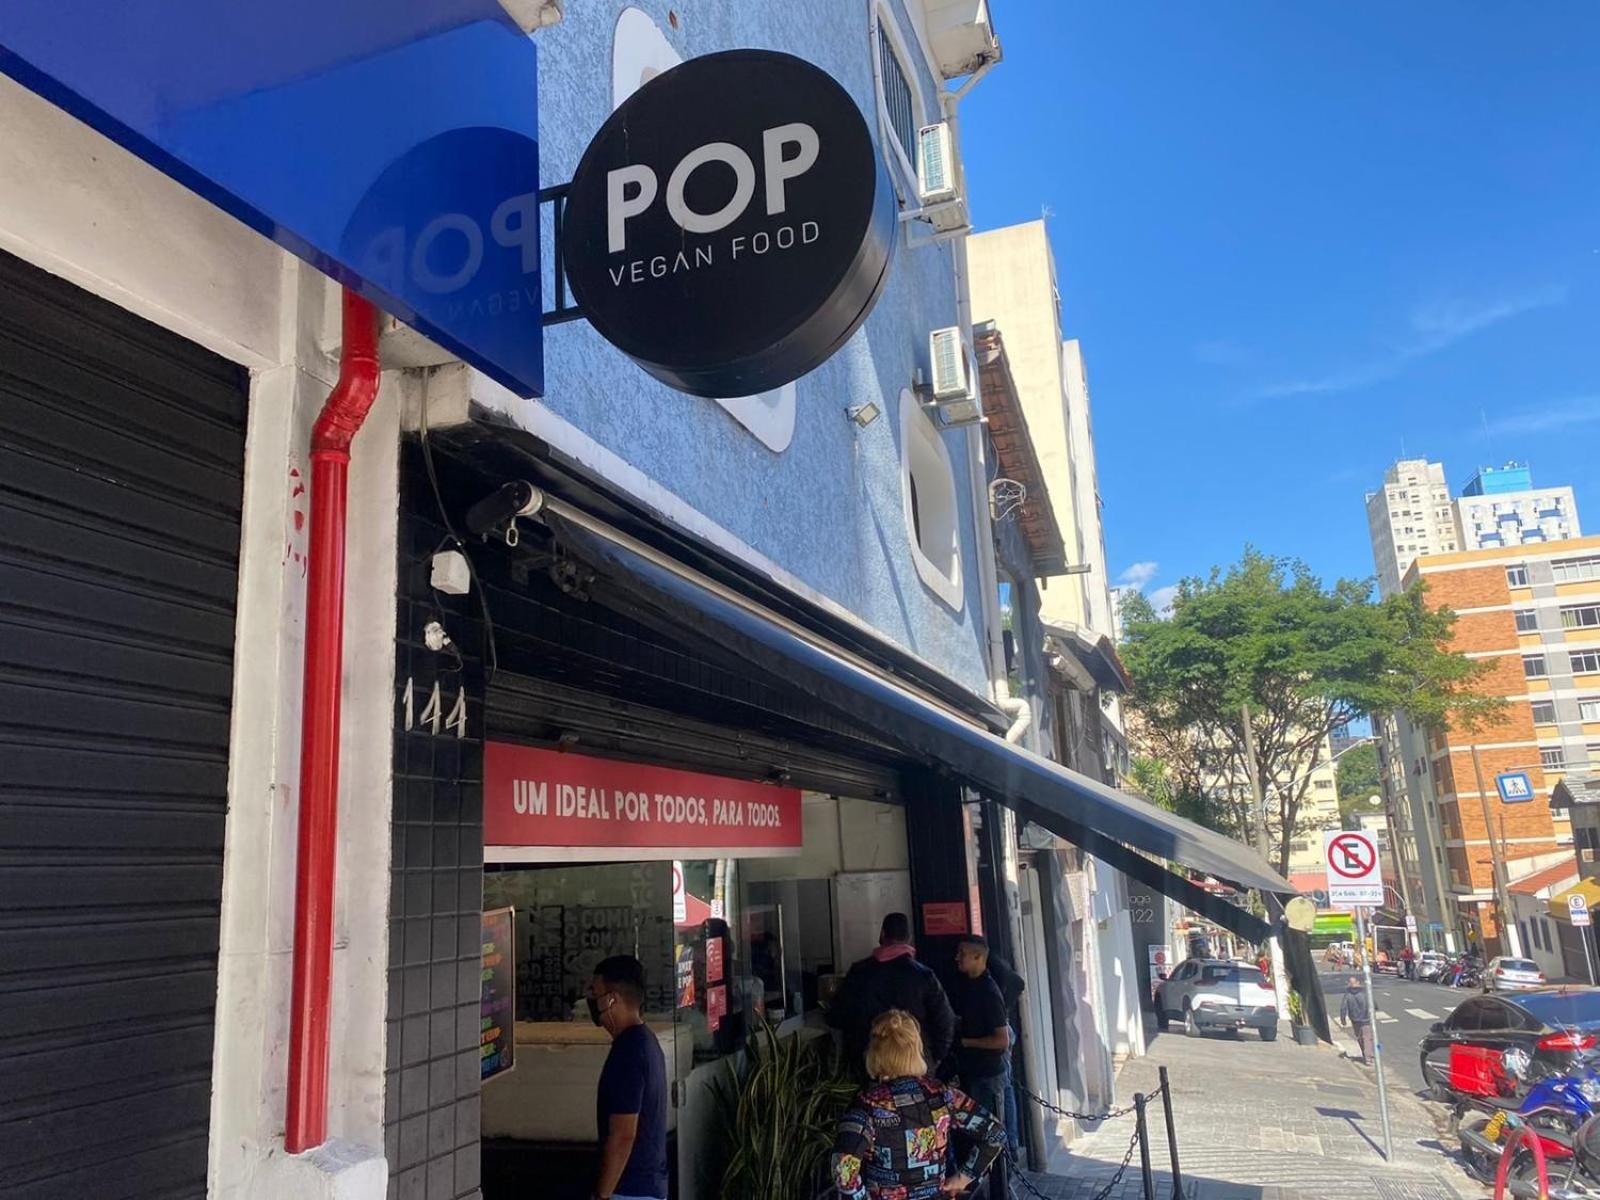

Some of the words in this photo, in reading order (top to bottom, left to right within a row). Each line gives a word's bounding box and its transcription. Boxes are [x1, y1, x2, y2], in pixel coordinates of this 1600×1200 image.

[607, 122, 820, 254] POP
[608, 245, 713, 287] VEGAN
[732, 221, 820, 259] FOOD
[402, 676, 468, 740] 144
[513, 779, 547, 816] UM
[555, 784, 610, 820] IDEAL
[614, 791, 650, 822] POR
[654, 794, 709, 827] TODOS,
[712, 799, 744, 826] PARA
[747, 802, 782, 828] TODOS.
[1343, 843, 1361, 869] E
